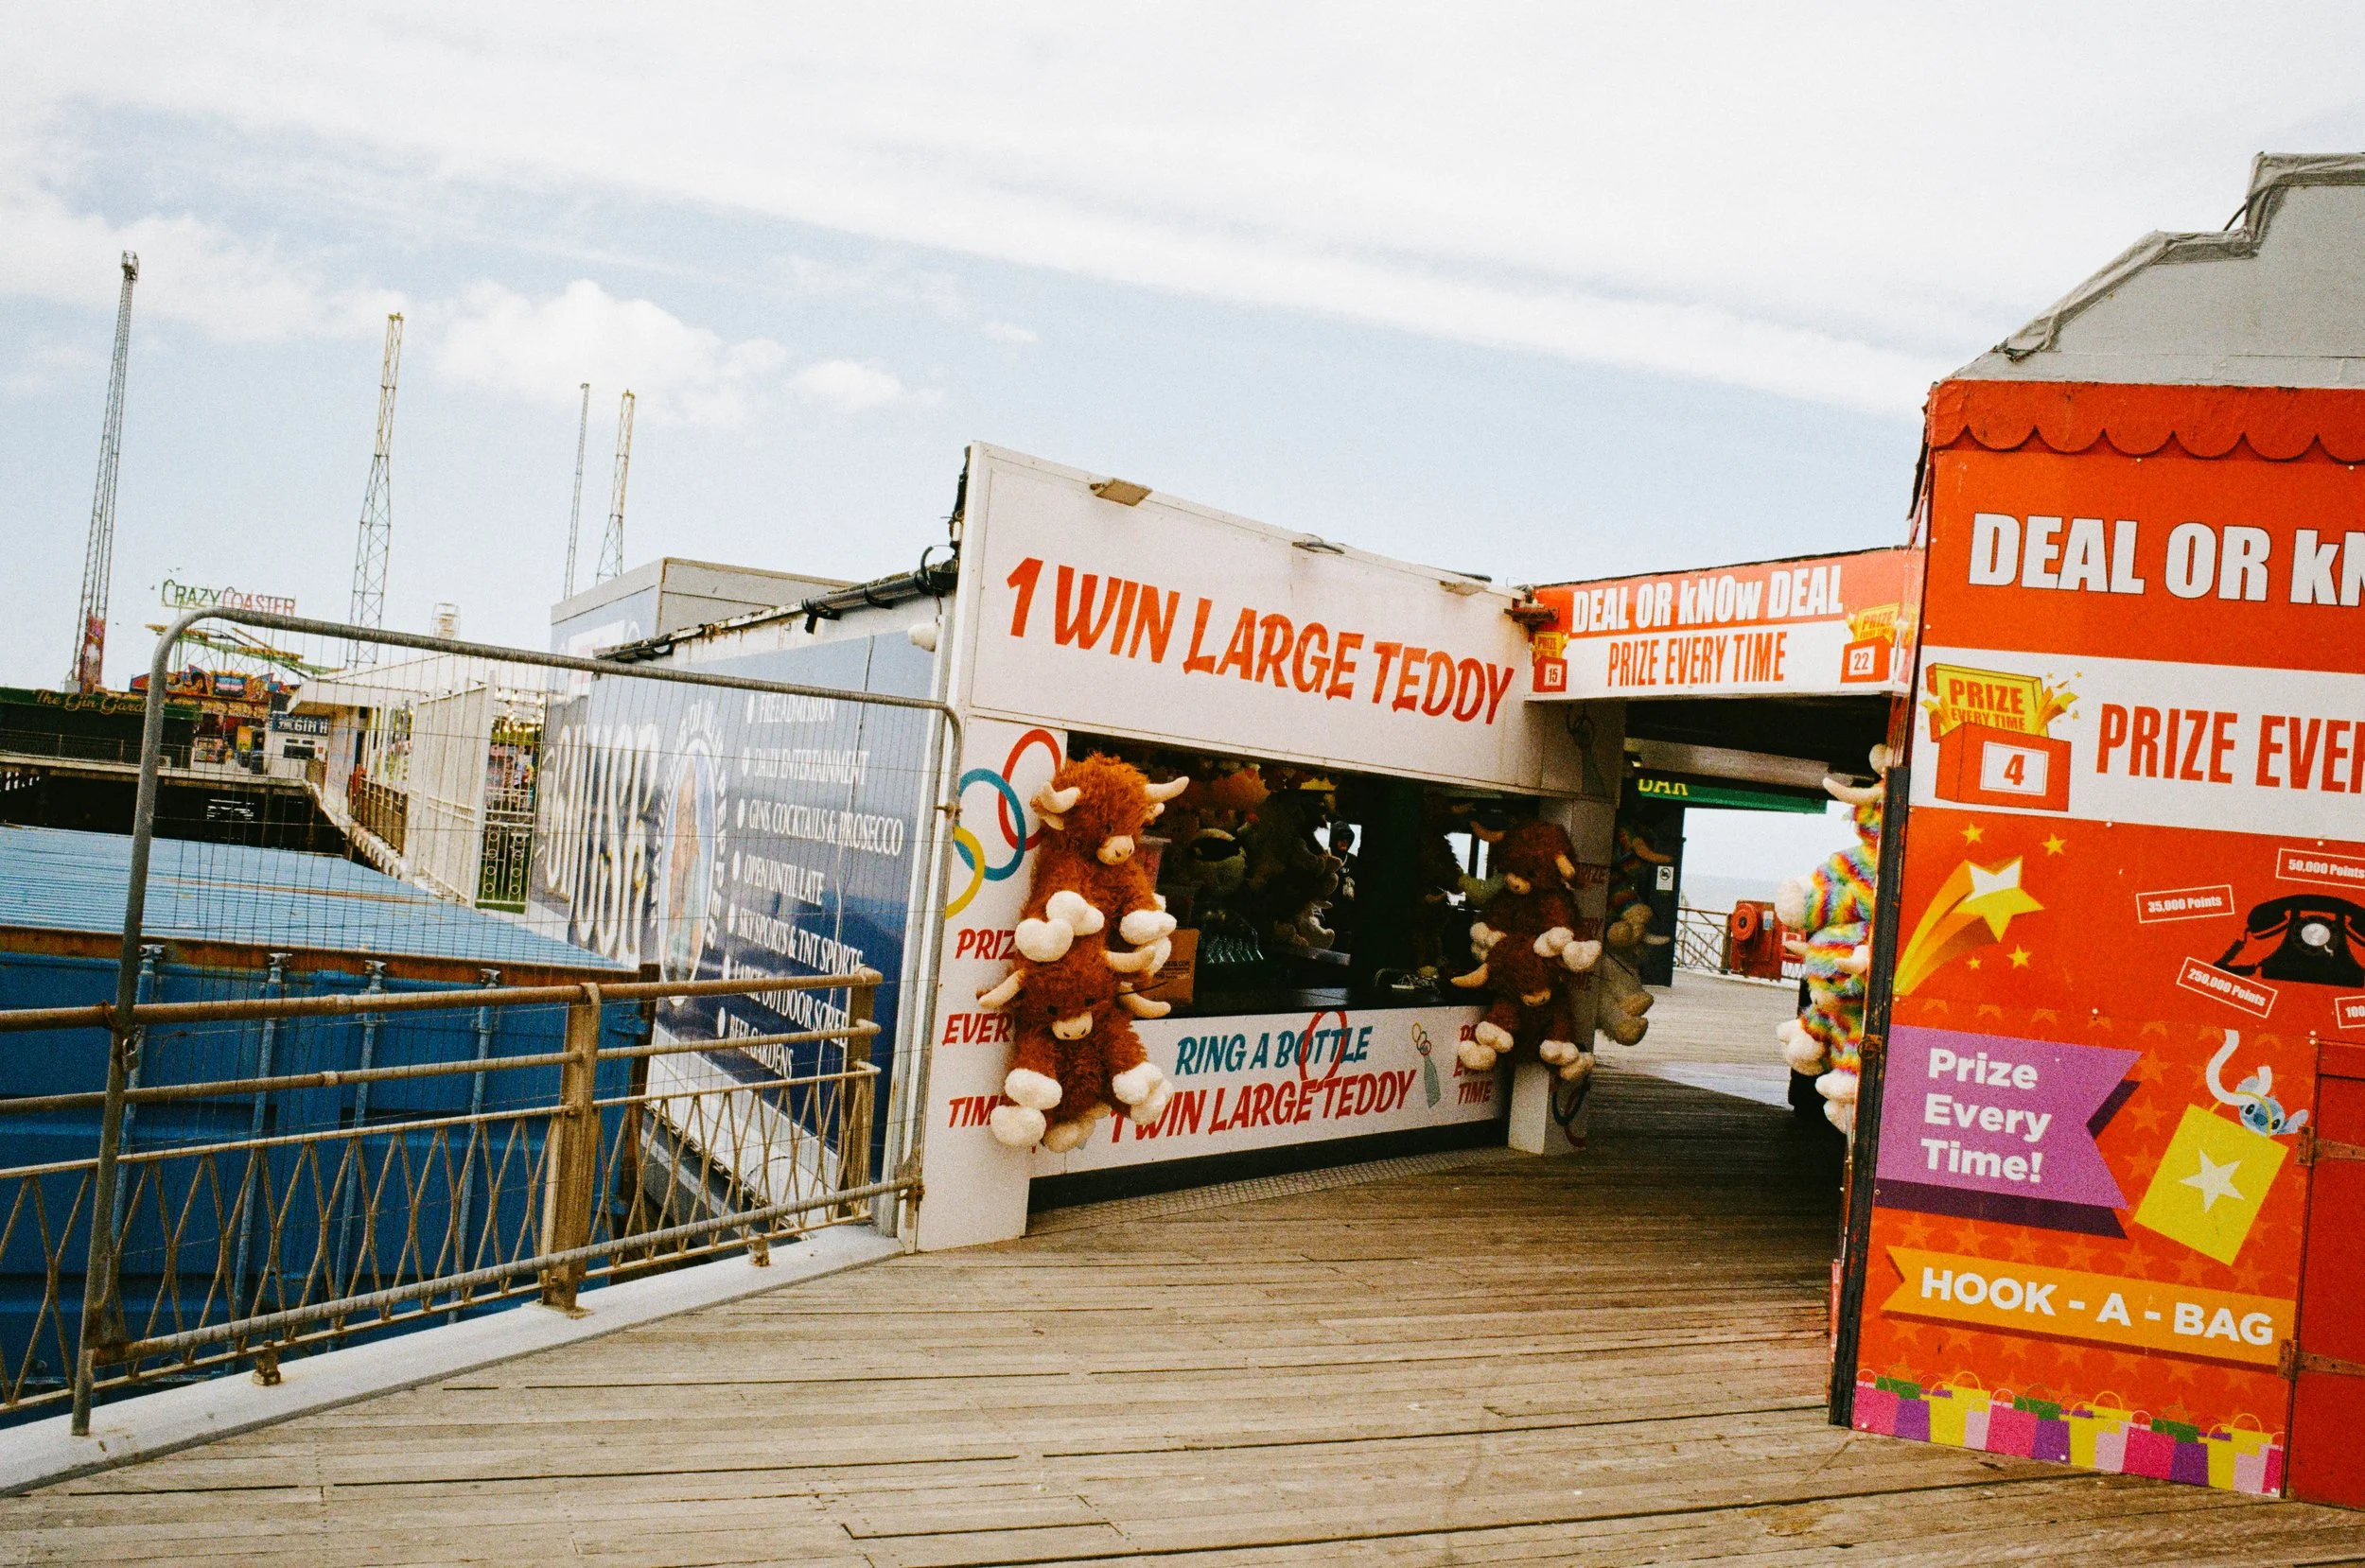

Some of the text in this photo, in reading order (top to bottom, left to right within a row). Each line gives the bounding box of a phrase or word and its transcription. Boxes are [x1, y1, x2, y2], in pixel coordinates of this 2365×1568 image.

[1968, 512, 2146, 596] DEAL
[2164, 521, 2271, 602] OR
[162, 578, 296, 616] CRAZY COASTER
[1571, 585, 1629, 634] DEAL
[1635, 583, 1673, 629] OR
[1767, 565, 1844, 619] DEAL
[1862, 611, 1894, 631] PRIZE
[1006, 556, 1515, 725] 1 WIN LARGE TEDDY
[1607, 631, 1788, 688] PRIZE EVERY TIME
[1548, 667, 1558, 682] 15
[1853, 652, 1869, 671] 22
[33, 689, 61, 706] The
[99, 697, 148, 716] Gard
[758, 694, 782, 723] FREE
[1948, 677, 2025, 715] PRIZE
[1950, 707, 2025, 731] EVERY TIME
[2095, 703, 2239, 785] PRIZE
[754, 747, 871, 785] DAILY ENTERTAINMENT
[2003, 753, 2025, 786] 4
[748, 798, 904, 858] GINS COCKTAILS & PROSECCO
[706, 769, 727, 950] PEPPER
[2329, 862, 2365, 880] Points
[743, 854, 769, 888] OPEN
[798, 867, 825, 906] LATE
[2186, 896, 2223, 910] Points
[738, 907, 755, 941] SKY
[754, 912, 789, 955] SPORTS
[787, 925, 797, 960] &
[797, 928, 821, 969] TNT
[955, 928, 1016, 961] PRIZ
[762, 976, 814, 1031] OUTDOOR
[813, 999, 849, 1049] SCREE
[2231, 984, 2267, 1007] Points
[942, 1012, 1014, 1045] EVER
[1176, 1024, 1373, 1076] RING A BOTTLE
[1928, 1046, 2039, 1089] Prize
[949, 1094, 998, 1128] TIM
[1208, 1078, 1319, 1136] LARGE
[1323, 1069, 1419, 1120] TEDDY
[1457, 1080, 1494, 1106] TIME
[1923, 1093, 2053, 1142] Every
[1919, 1138, 2043, 1183] Time!
[1919, 1266, 2058, 1315] HOOK
[2095, 1292, 2132, 1327] A
[2173, 1302, 2274, 1346] BAG
